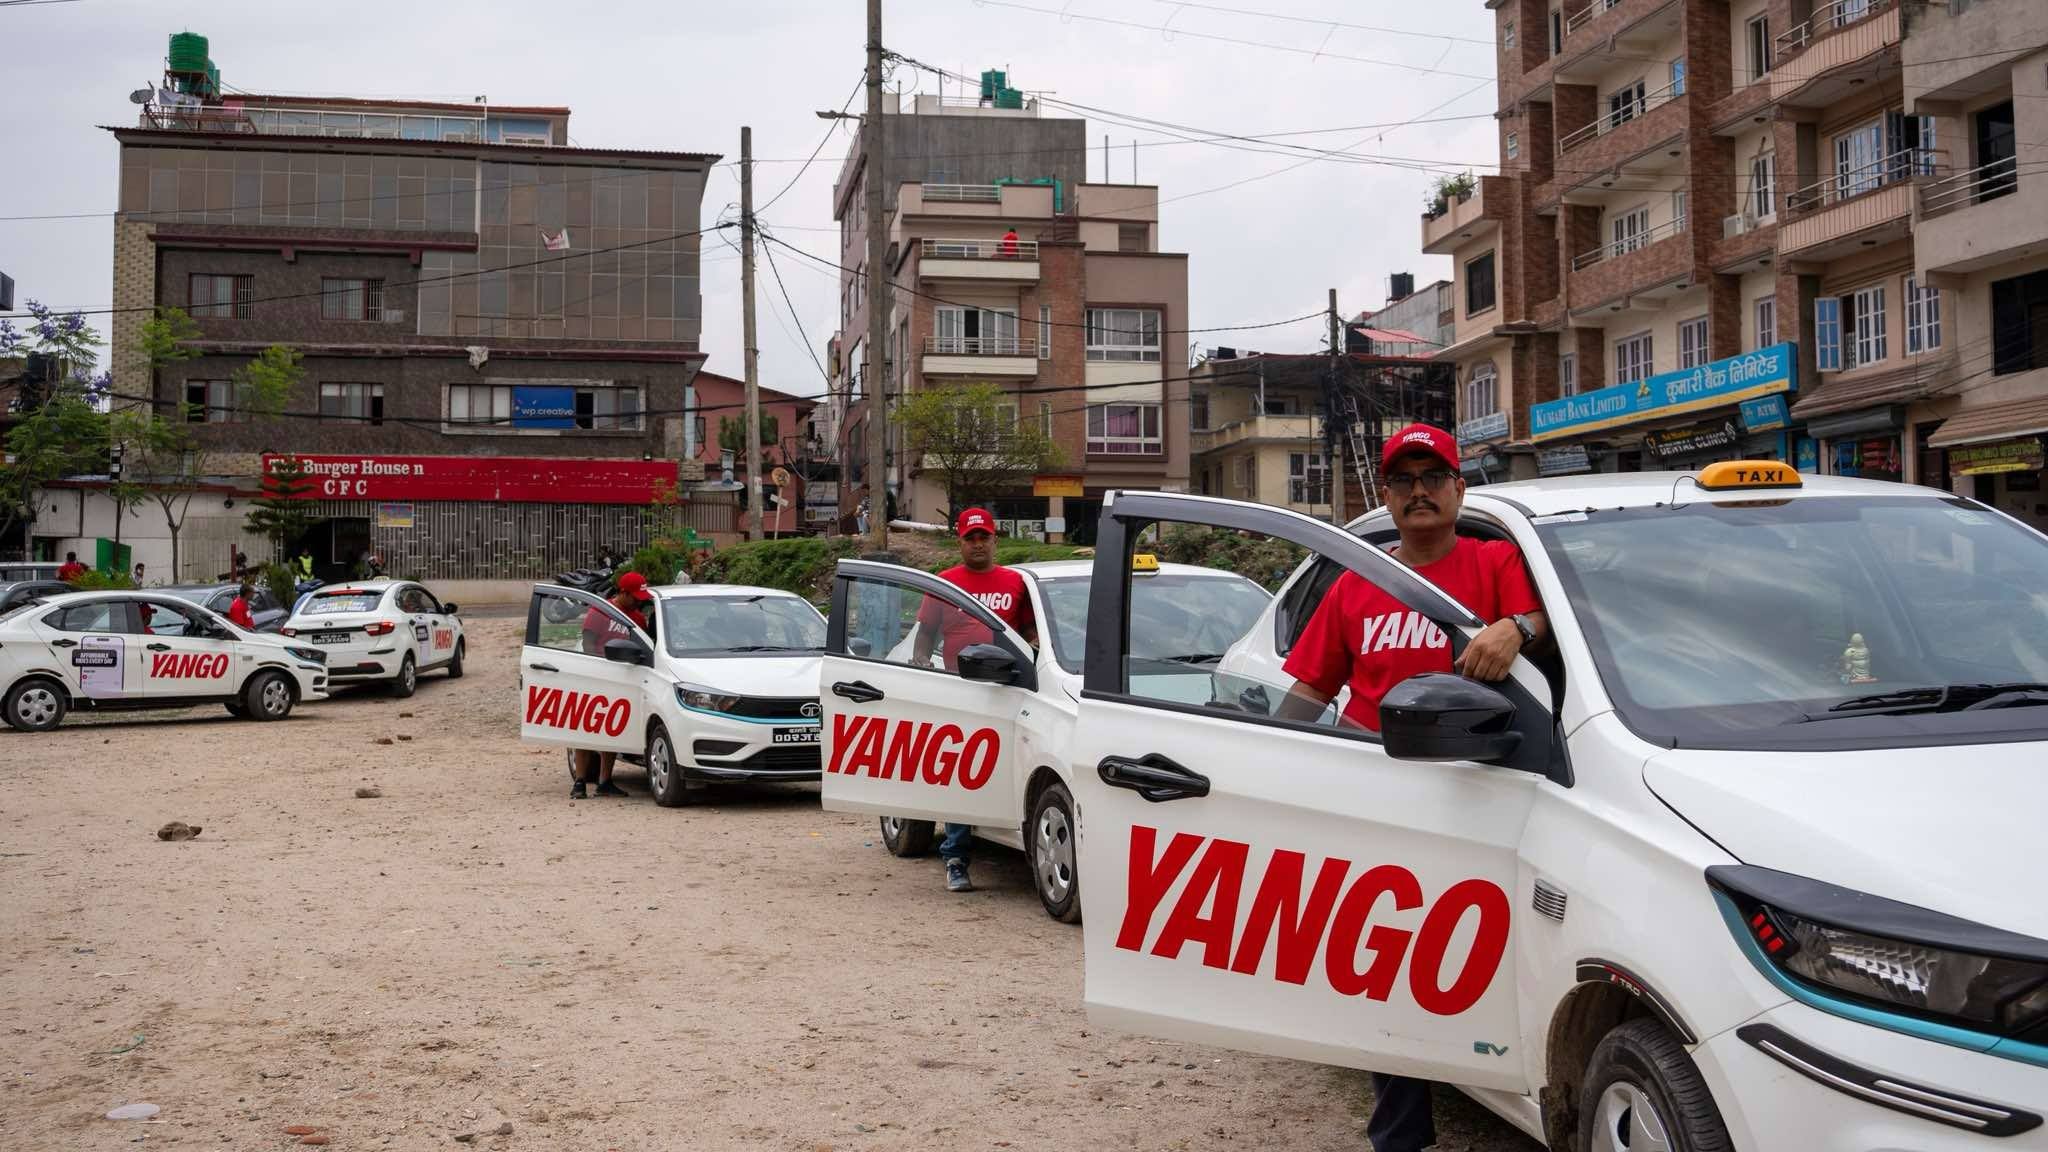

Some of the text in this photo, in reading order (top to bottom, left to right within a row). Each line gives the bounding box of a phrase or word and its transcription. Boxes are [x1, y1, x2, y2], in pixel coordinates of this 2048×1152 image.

[1666, 370, 1702, 403] कुमारी
[1729, 354, 1779, 385] लिमिटेड
[1536, 408, 1566, 428] KUMARI
[1567, 401, 1590, 420] BANK
[1591, 396, 1626, 416] LIMITED
[1757, 402, 1778, 417] ATM
[1696, 430, 1728, 449] CLINIC
[303, 459, 358, 478] Burger
[361, 460, 410, 475] House
[1736, 470, 1783, 482] TAXI
[434, 629, 452, 649] YANGO
[1361, 611, 1448, 655] YANG
[150, 654, 229, 679] YANGO
[526, 686, 631, 737] YANGO
[827, 714, 1000, 791] YANGO
[1115, 824, 1511, 1016] YANGO
[1473, 1041, 1509, 1056] EV
